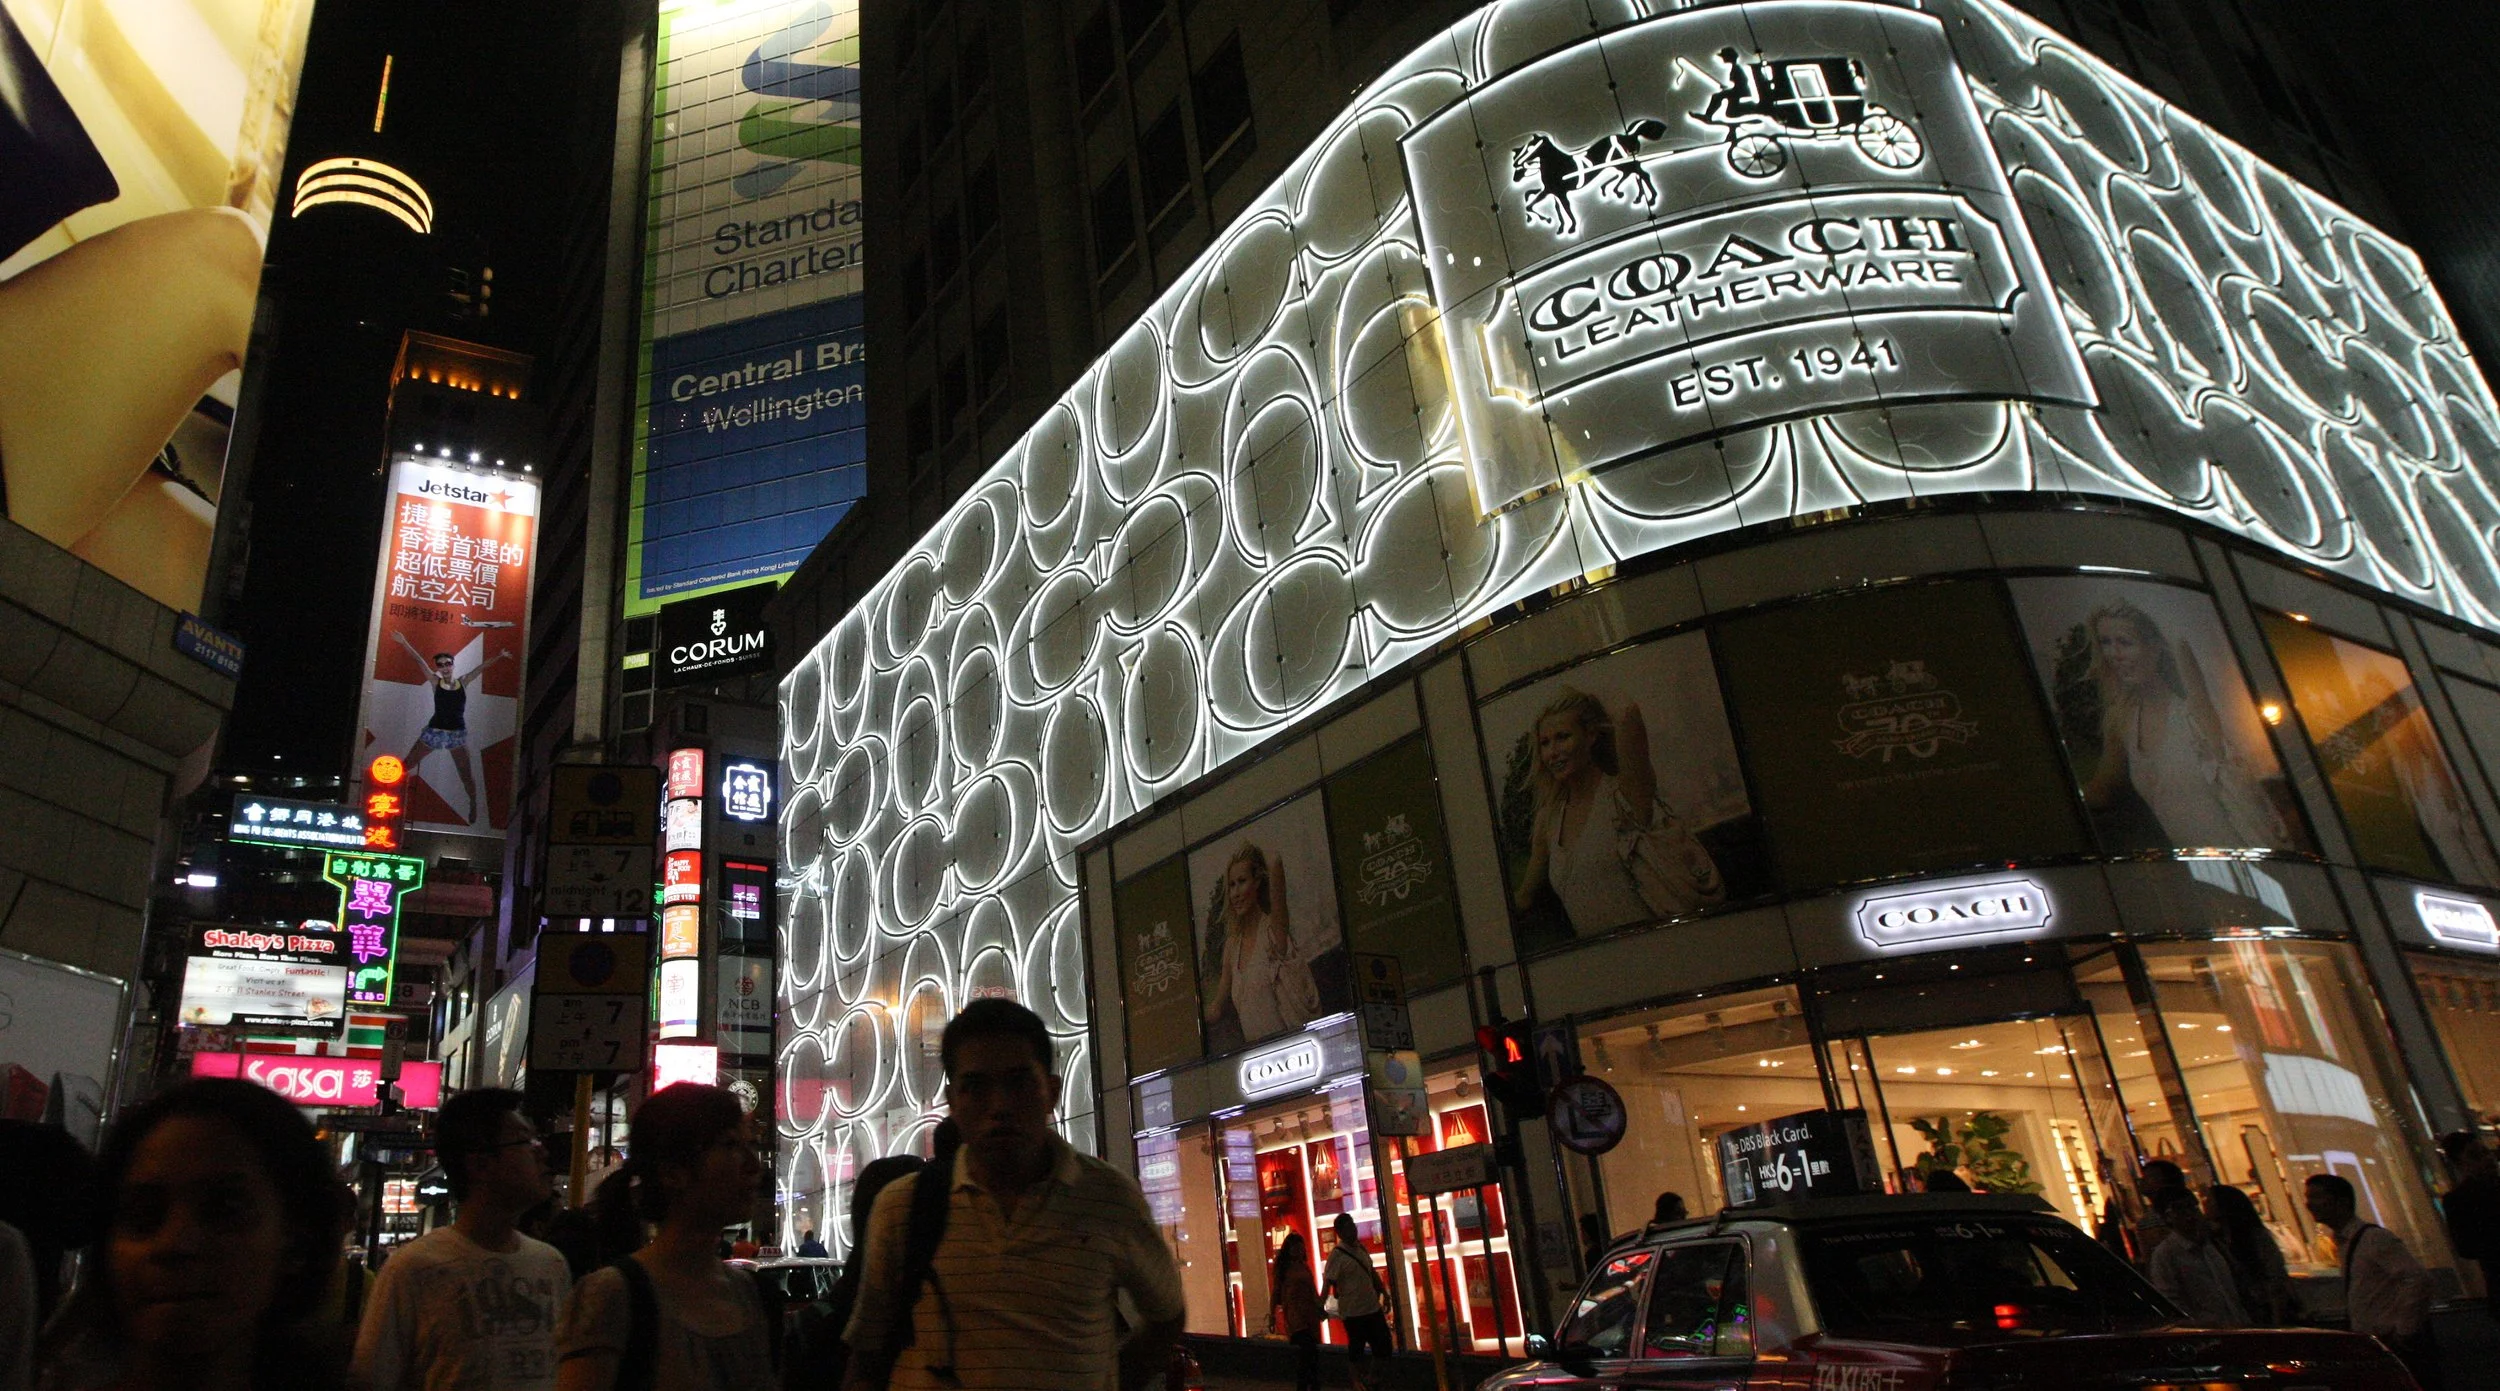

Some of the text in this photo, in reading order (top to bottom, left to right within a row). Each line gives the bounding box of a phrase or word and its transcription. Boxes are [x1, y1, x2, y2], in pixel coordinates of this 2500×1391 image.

[713, 198, 863, 256] Standa
[704, 239, 863, 299] Charter
[1528, 216, 1970, 334] COACH
[1554, 260, 1963, 361] LEATHERWARE
[671, 349, 803, 402] Central
[1669, 336, 1898, 411] EST. 1941
[702, 383, 864, 434] Wellington
[418, 479, 489, 503] Jetstar
[398, 526, 525, 567] 香港首選的
[394, 550, 500, 588] 超低票價
[672, 578, 699, 589] Standard
[698, 573, 726, 584] Chartered
[726, 570, 741, 579] Bank
[777, 559, 800, 570] Limited
[390, 573, 496, 611] 航空公司
[670, 630, 765, 665] CORUM
[615, 850, 631, 873] 7
[612, 889, 645, 912] 12
[1877, 896, 2029, 928] COACH
[347, 879, 393, 964] 翠華
[204, 929, 335, 954] Shakey's Pizza
[245, 987, 276, 997] Stanley
[278, 988, 305, 998] Street
[728, 998, 760, 1010] NCB
[606, 1001, 623, 1024] 7
[604, 1040, 621, 1065] 7
[1247, 1053, 1310, 1082] COACH
[1726, 1122, 1813, 1155] The DBS Black Card.
